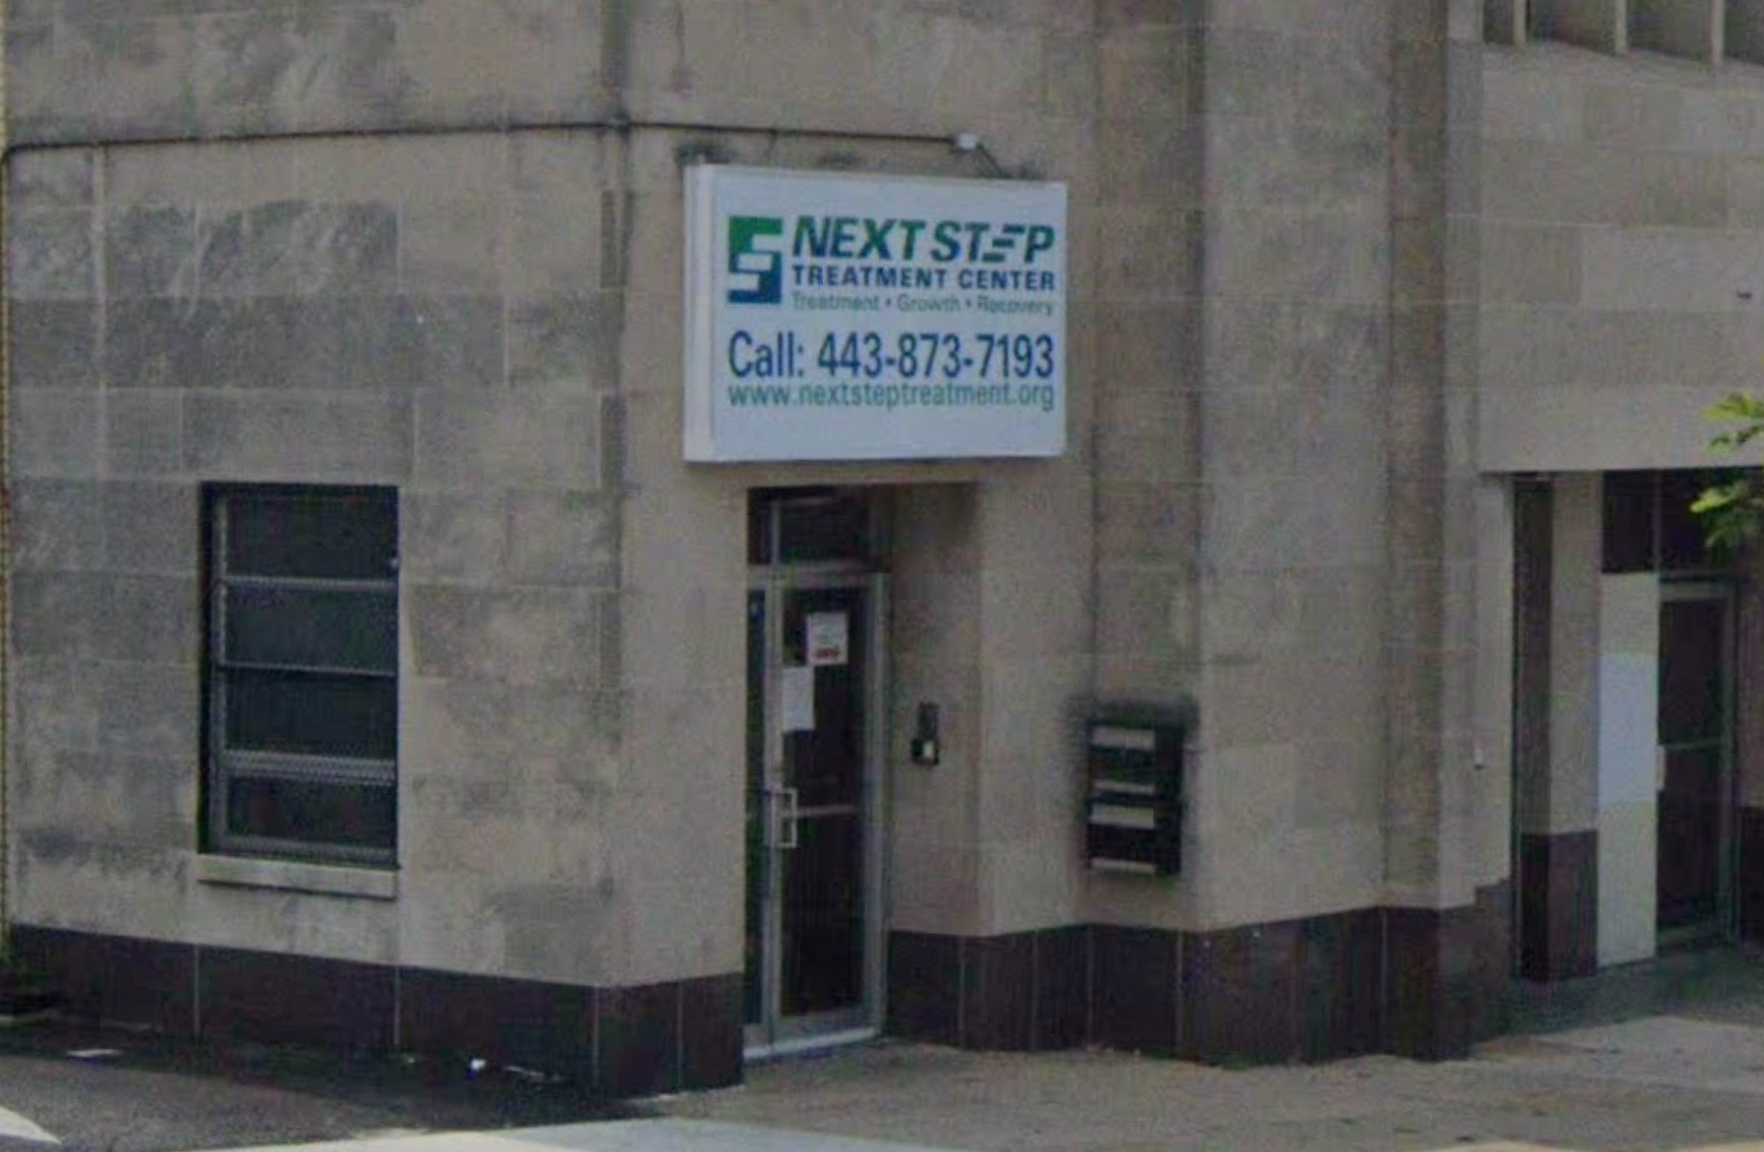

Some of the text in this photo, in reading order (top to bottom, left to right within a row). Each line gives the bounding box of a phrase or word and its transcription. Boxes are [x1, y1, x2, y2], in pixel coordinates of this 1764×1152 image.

[792, 216, 1055, 263] NEXT STEP
[792, 264, 1055, 291] TREATMENT CENTER
[792, 291, 1053, 316] Treatment Growth Recovery
[728, 331, 1054, 379] Call: 443-873-7193
[728, 383, 1055, 412] www.nextsteptreatment.org
